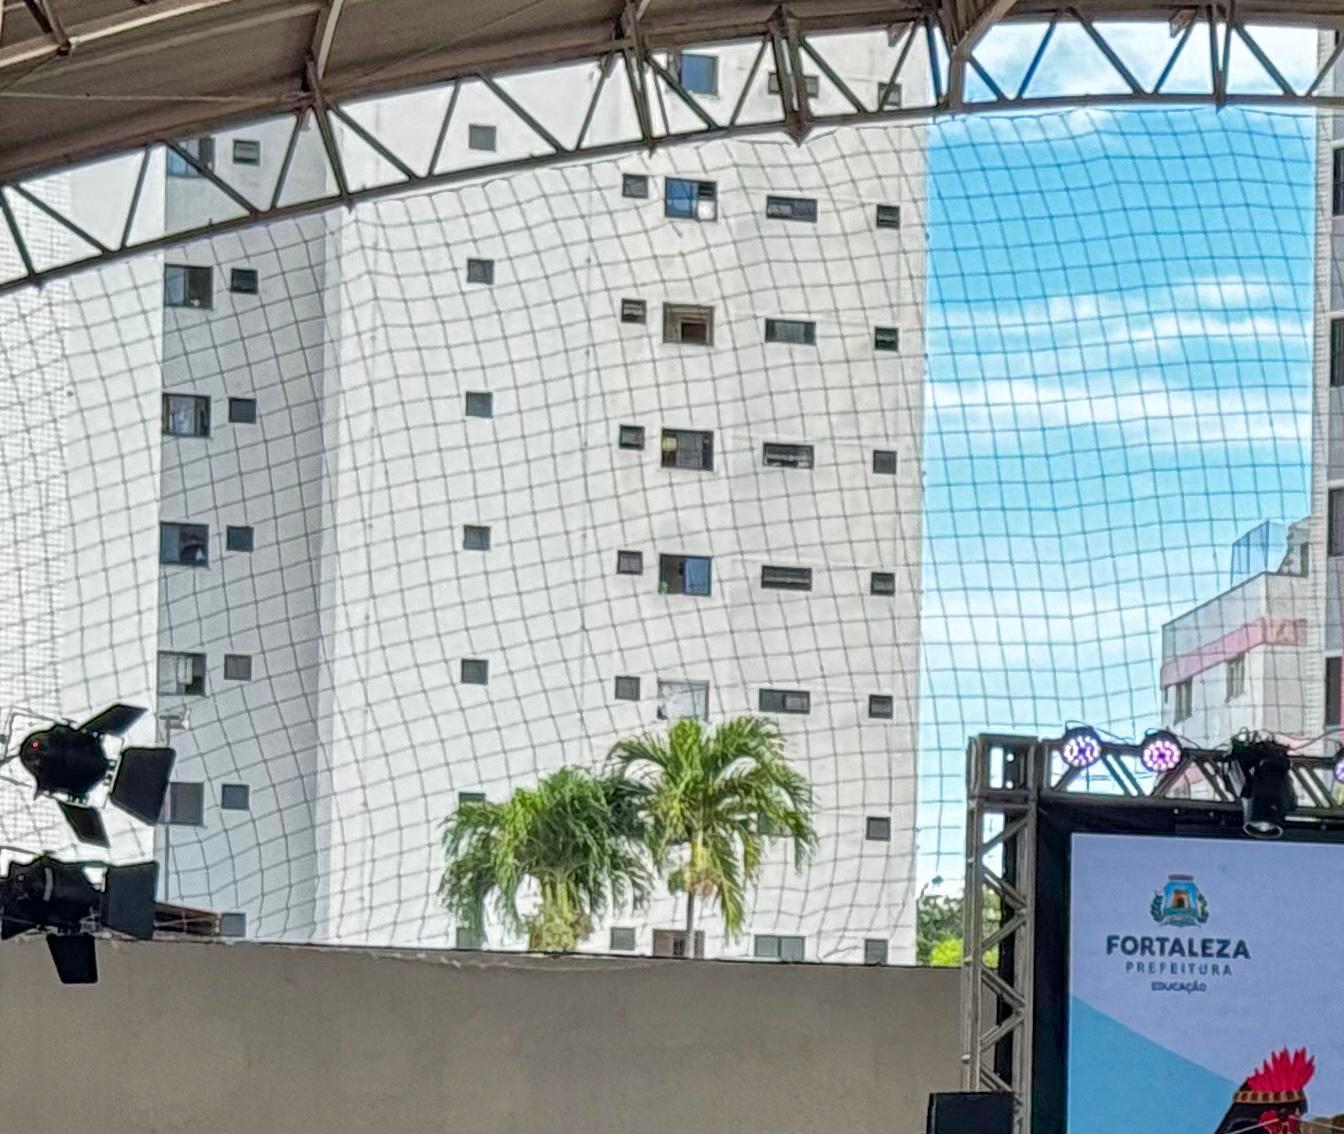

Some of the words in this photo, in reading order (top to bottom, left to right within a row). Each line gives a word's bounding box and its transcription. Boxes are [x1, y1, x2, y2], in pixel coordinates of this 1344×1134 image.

[1106, 935, 1251, 960] FORTALEZA
[1126, 961, 1232, 977] PREFEITURA
[1151, 980, 1207, 994] EDUCAÇÃO
